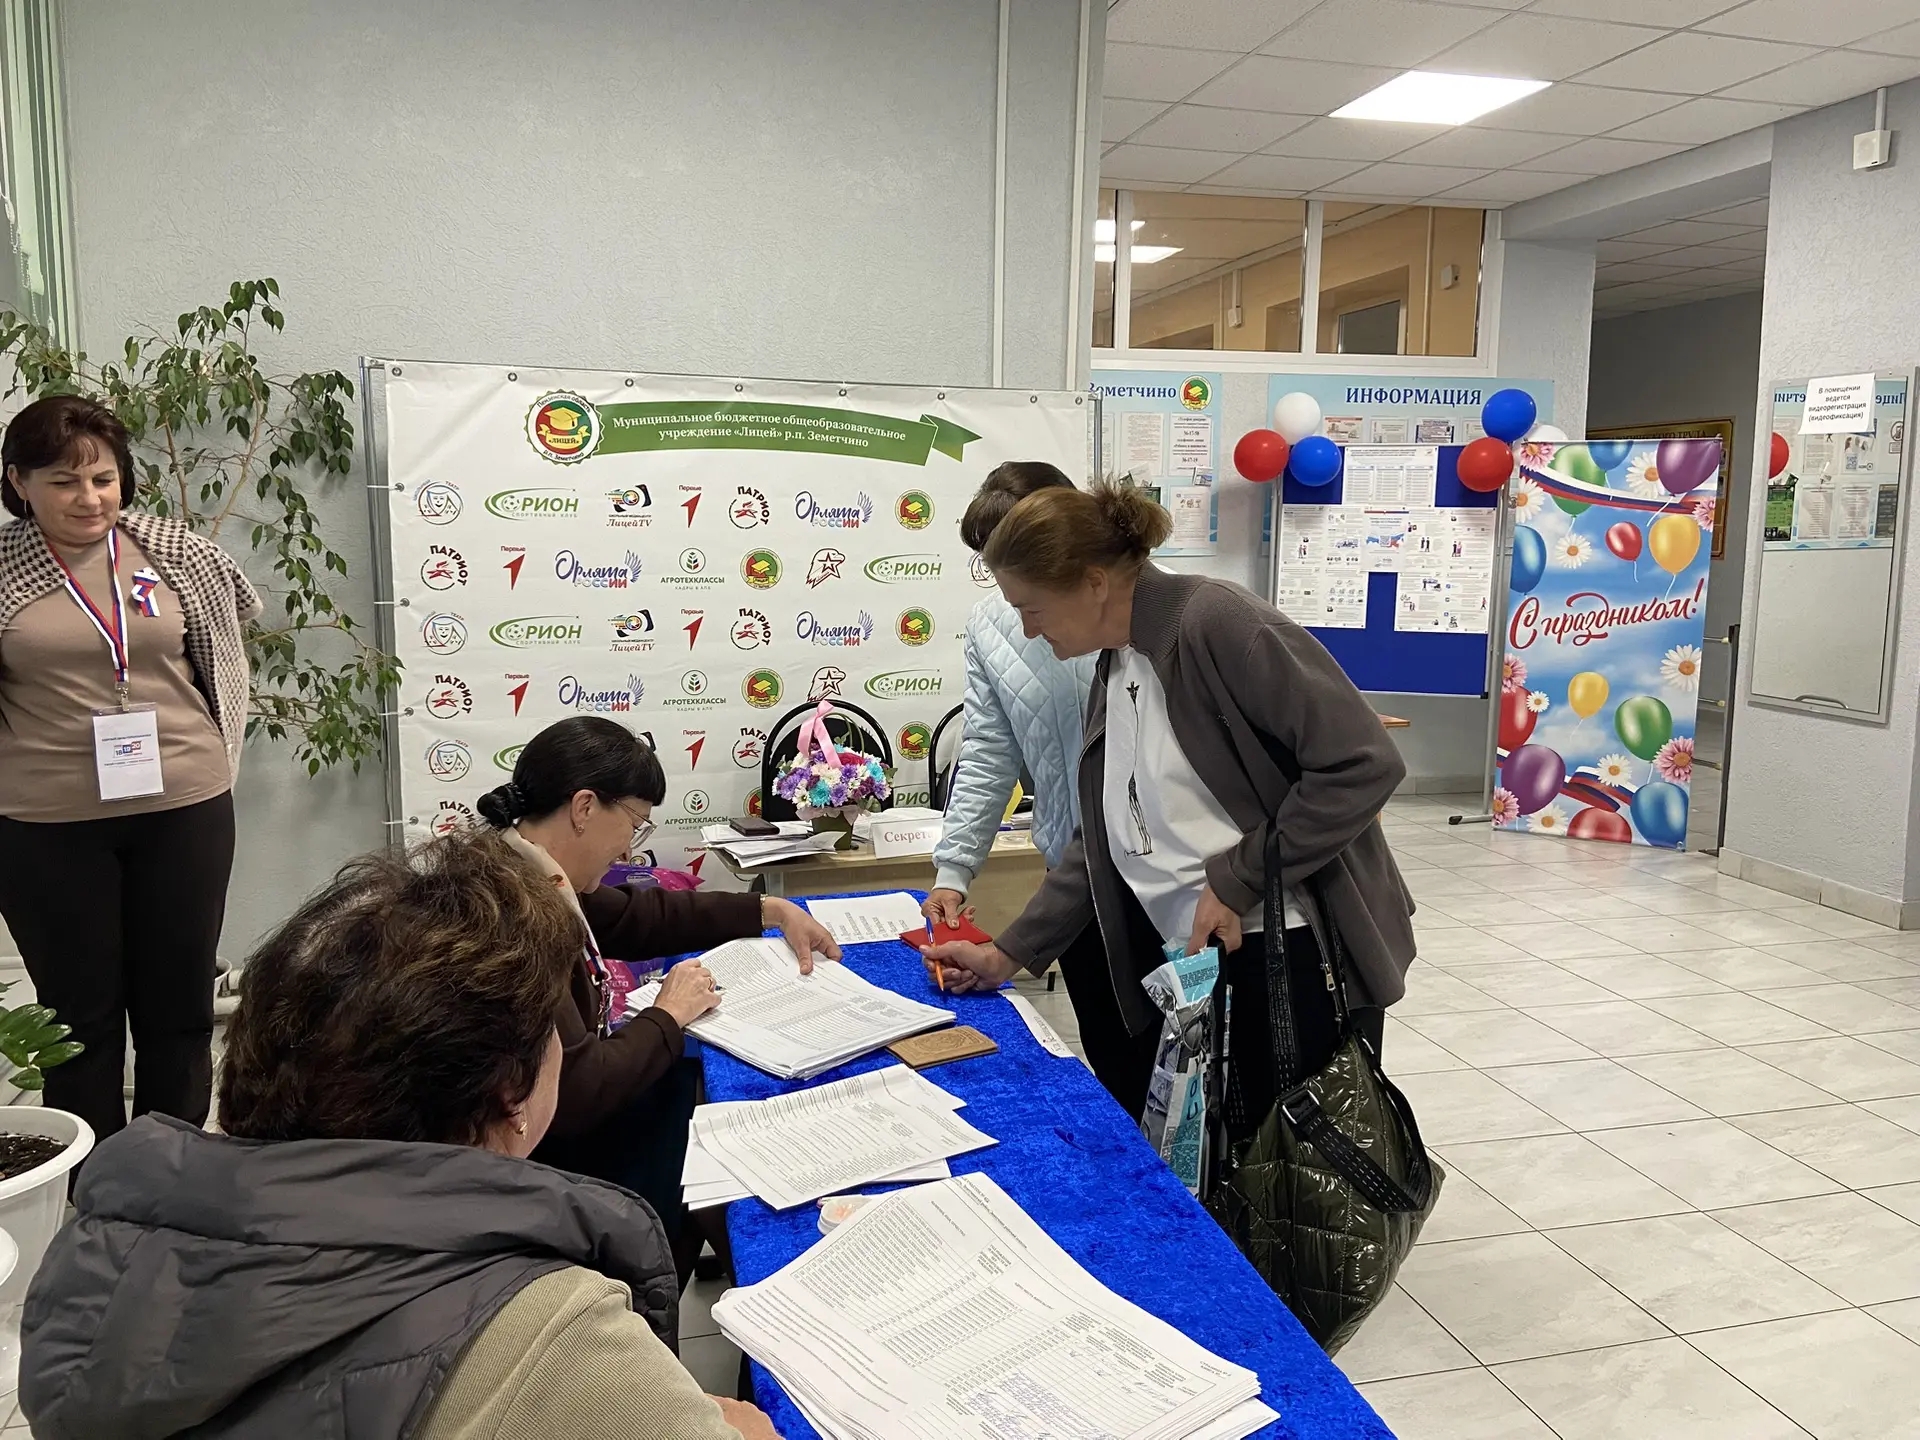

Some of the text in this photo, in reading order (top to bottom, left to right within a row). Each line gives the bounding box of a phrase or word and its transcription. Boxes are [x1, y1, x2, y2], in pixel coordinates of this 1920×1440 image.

[1346, 387, 1482, 408] ИНФОРМАЦИЯ
[1824, 385, 1861, 394] помещении
[1808, 402, 1867, 412] видеорегистрация
[612, 411, 906, 441] Муниципальное бюджетное общеобразовательное
[658, 426, 869, 447] учреждение «Лицей» р.п. Земетчино
[678, 484, 702, 493] Первые
[737, 485, 770, 525] ПАТРИОТ
[795, 490, 860, 523] Орлята
[500, 545, 526, 553] Первые
[430, 545, 468, 586] ПАТРИОТ
[555, 549, 628, 583] Орлята
[796, 610, 861, 642] Орлята
[1508, 577, 1705, 650] С праздником!
[738, 607, 771, 646] ПАТРИОТ
[504, 673, 530, 681] Первые
[434, 674, 473, 714] ПАТРИОТ
[558, 675, 631, 708] Орлята
[662, 697, 727, 706] АГРОТЕХКЛАССЫ
[740, 727, 768, 746] ПАТР
[664, 816, 729, 825] АГРОТЕХКЛАССЫ
